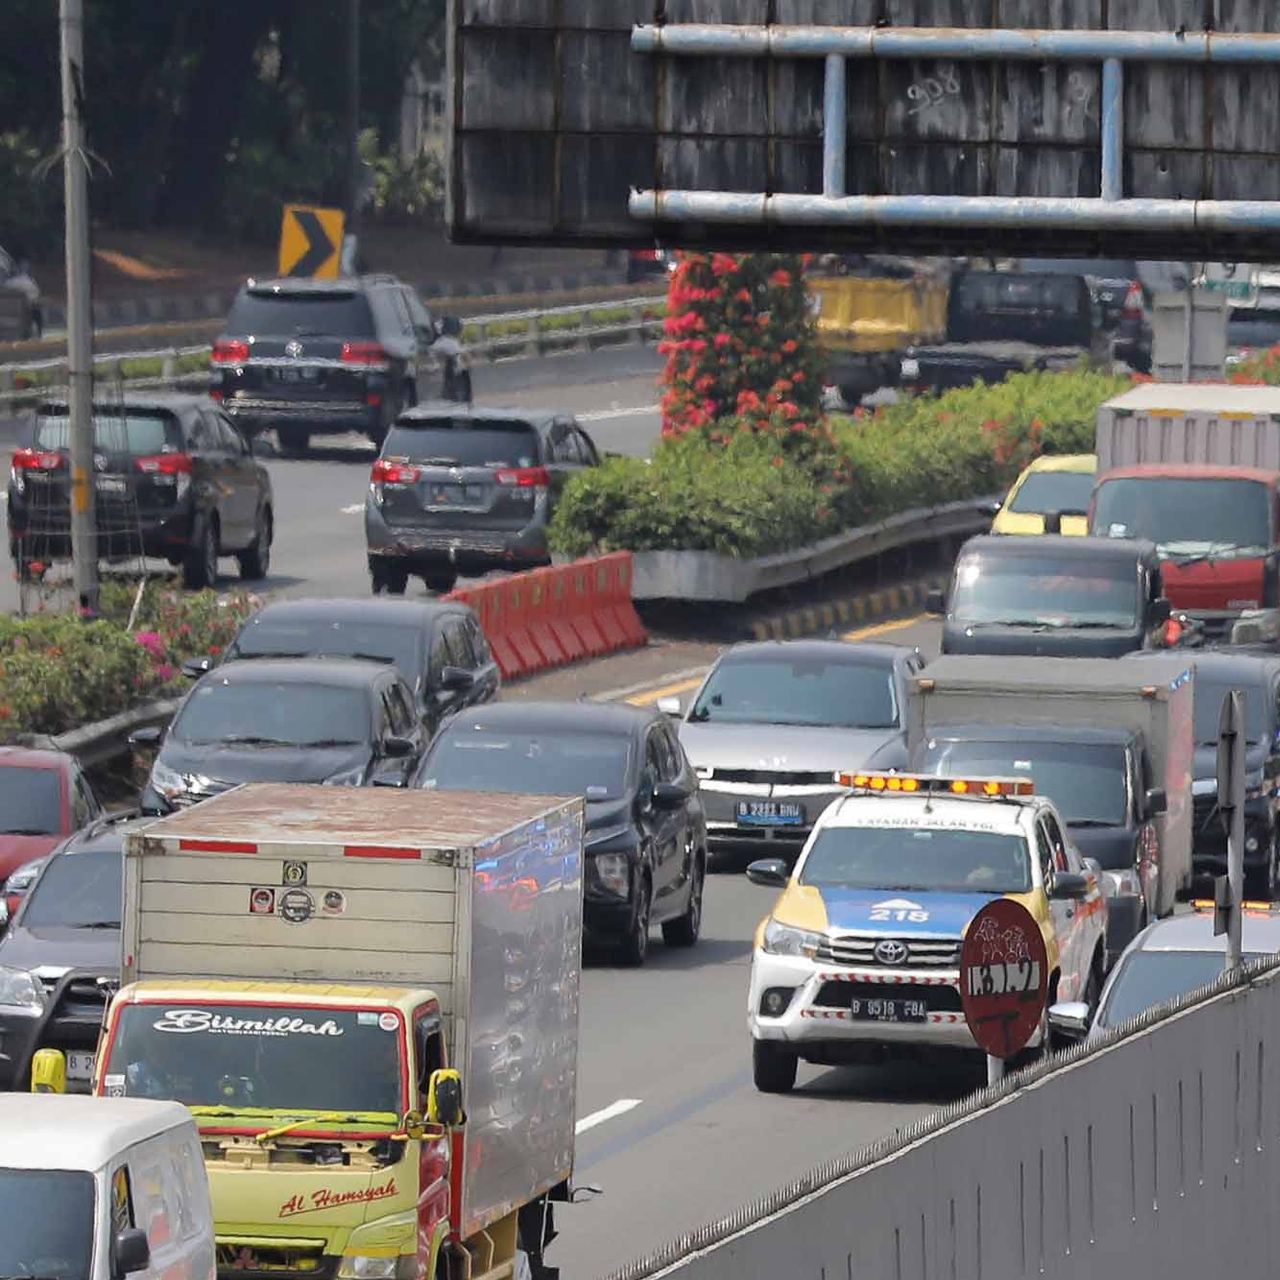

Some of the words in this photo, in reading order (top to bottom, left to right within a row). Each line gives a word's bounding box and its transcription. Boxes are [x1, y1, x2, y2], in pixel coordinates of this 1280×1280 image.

[868, 909, 930, 922] 218
[852, 1000, 860, 1013] B
[153, 1009, 343, 1036] Bismillah
[279, 1195, 304, 1217] Al
[311, 1178, 400, 1207] Hamsyah
